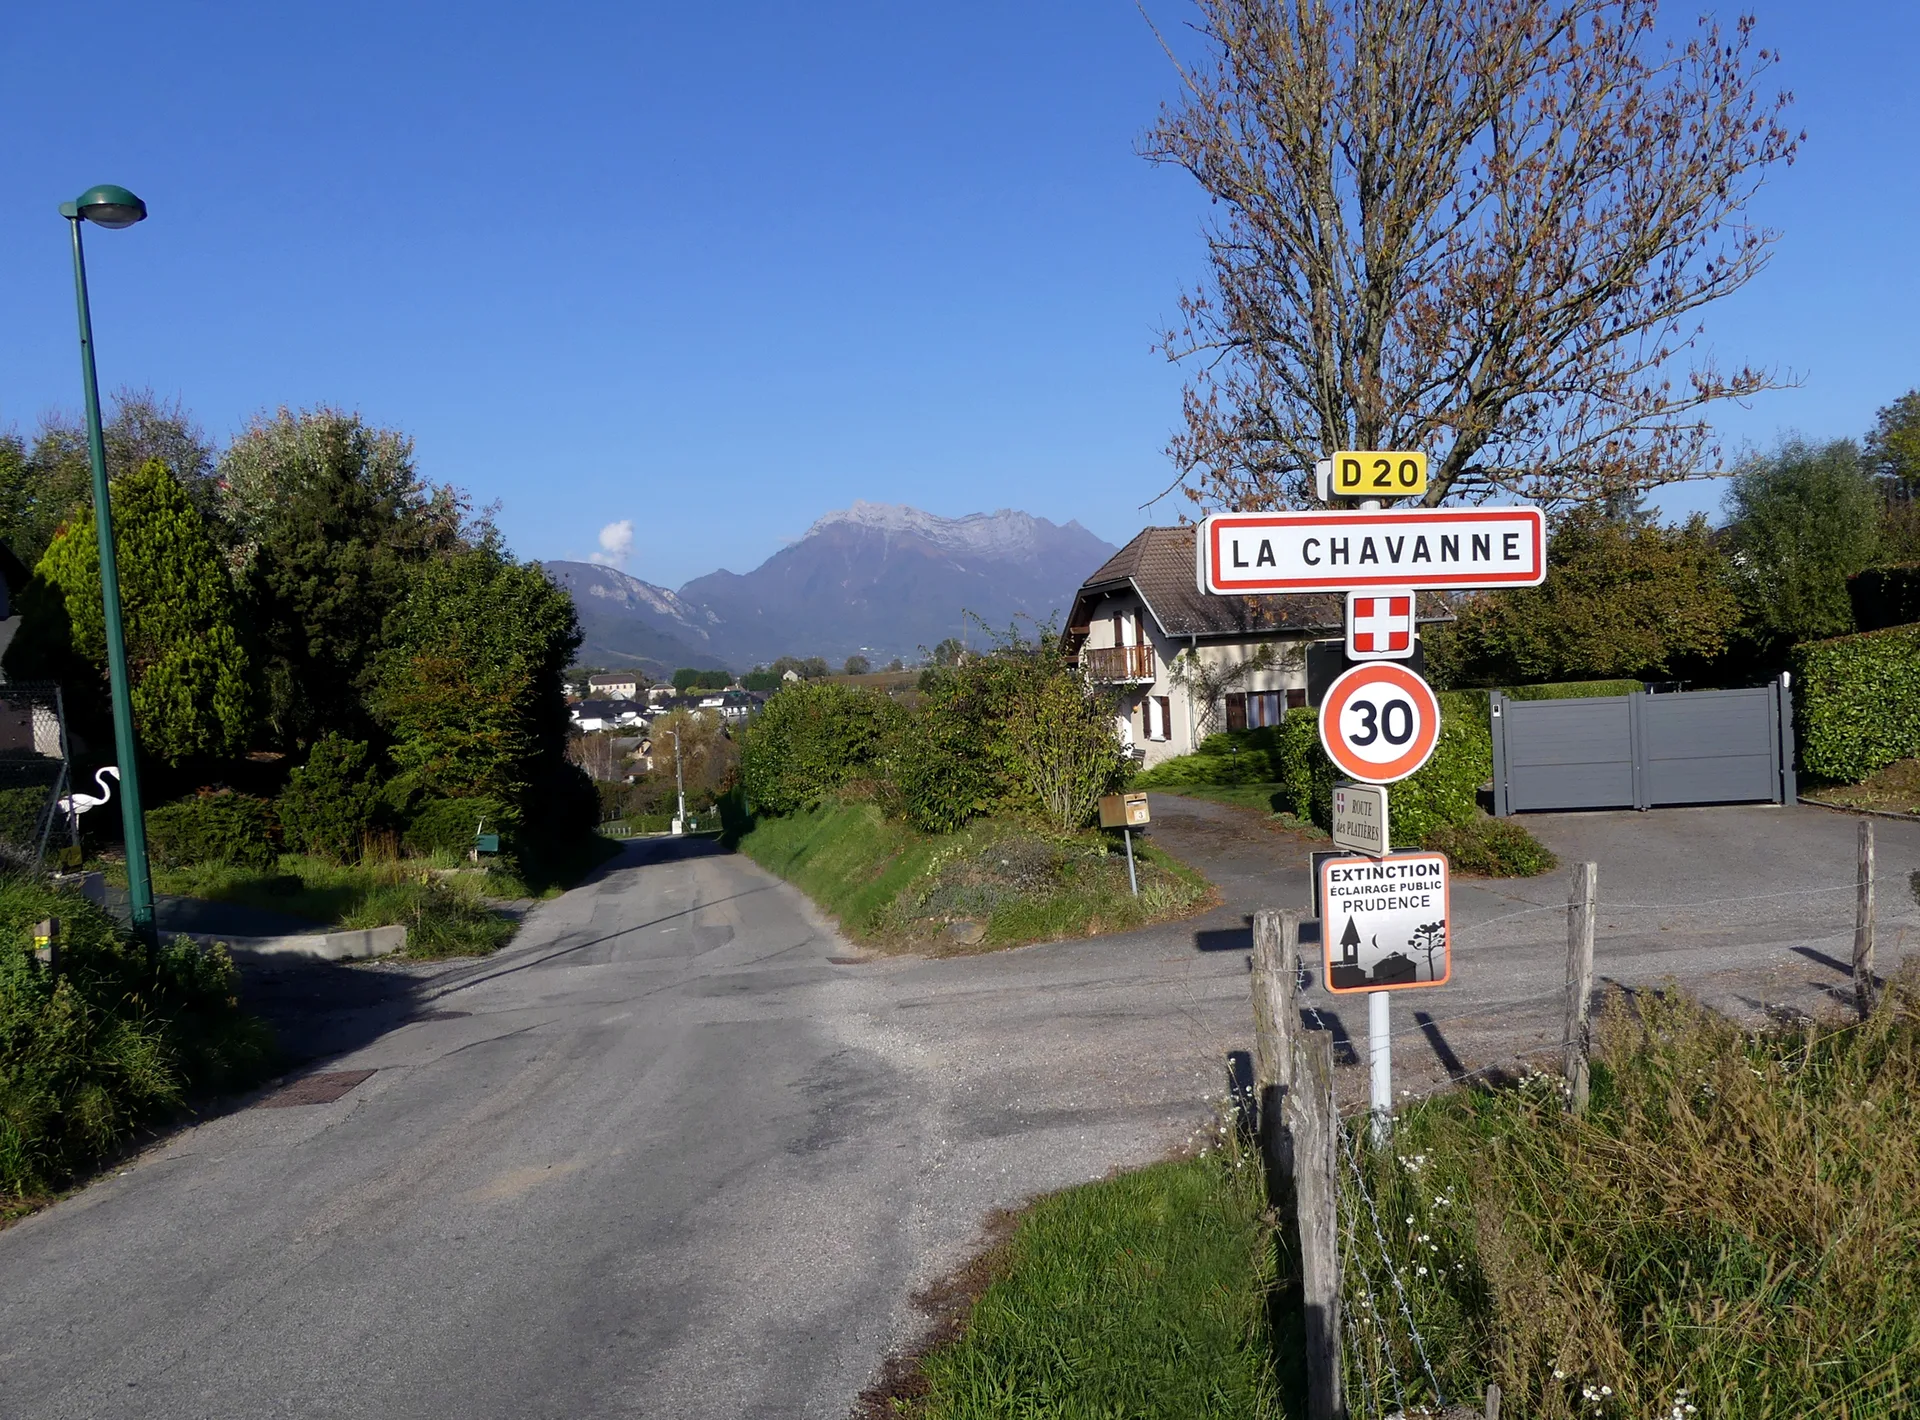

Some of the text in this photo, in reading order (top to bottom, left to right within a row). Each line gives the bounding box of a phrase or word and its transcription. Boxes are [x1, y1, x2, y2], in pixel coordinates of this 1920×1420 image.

[1342, 459, 1418, 487] D 20
[1233, 533, 1520, 568] LA CHAVANNE
[1349, 699, 1413, 746] 30
[1352, 800, 1372, 816] ROUTE
[1336, 819, 1379, 841] des PLATIÈRES
[1331, 863, 1440, 882] EXTINCTION
[1330, 881, 1442, 896] ÉCLAIRAGE PUBLIC
[1343, 895, 1430, 913] PRUDENCE
